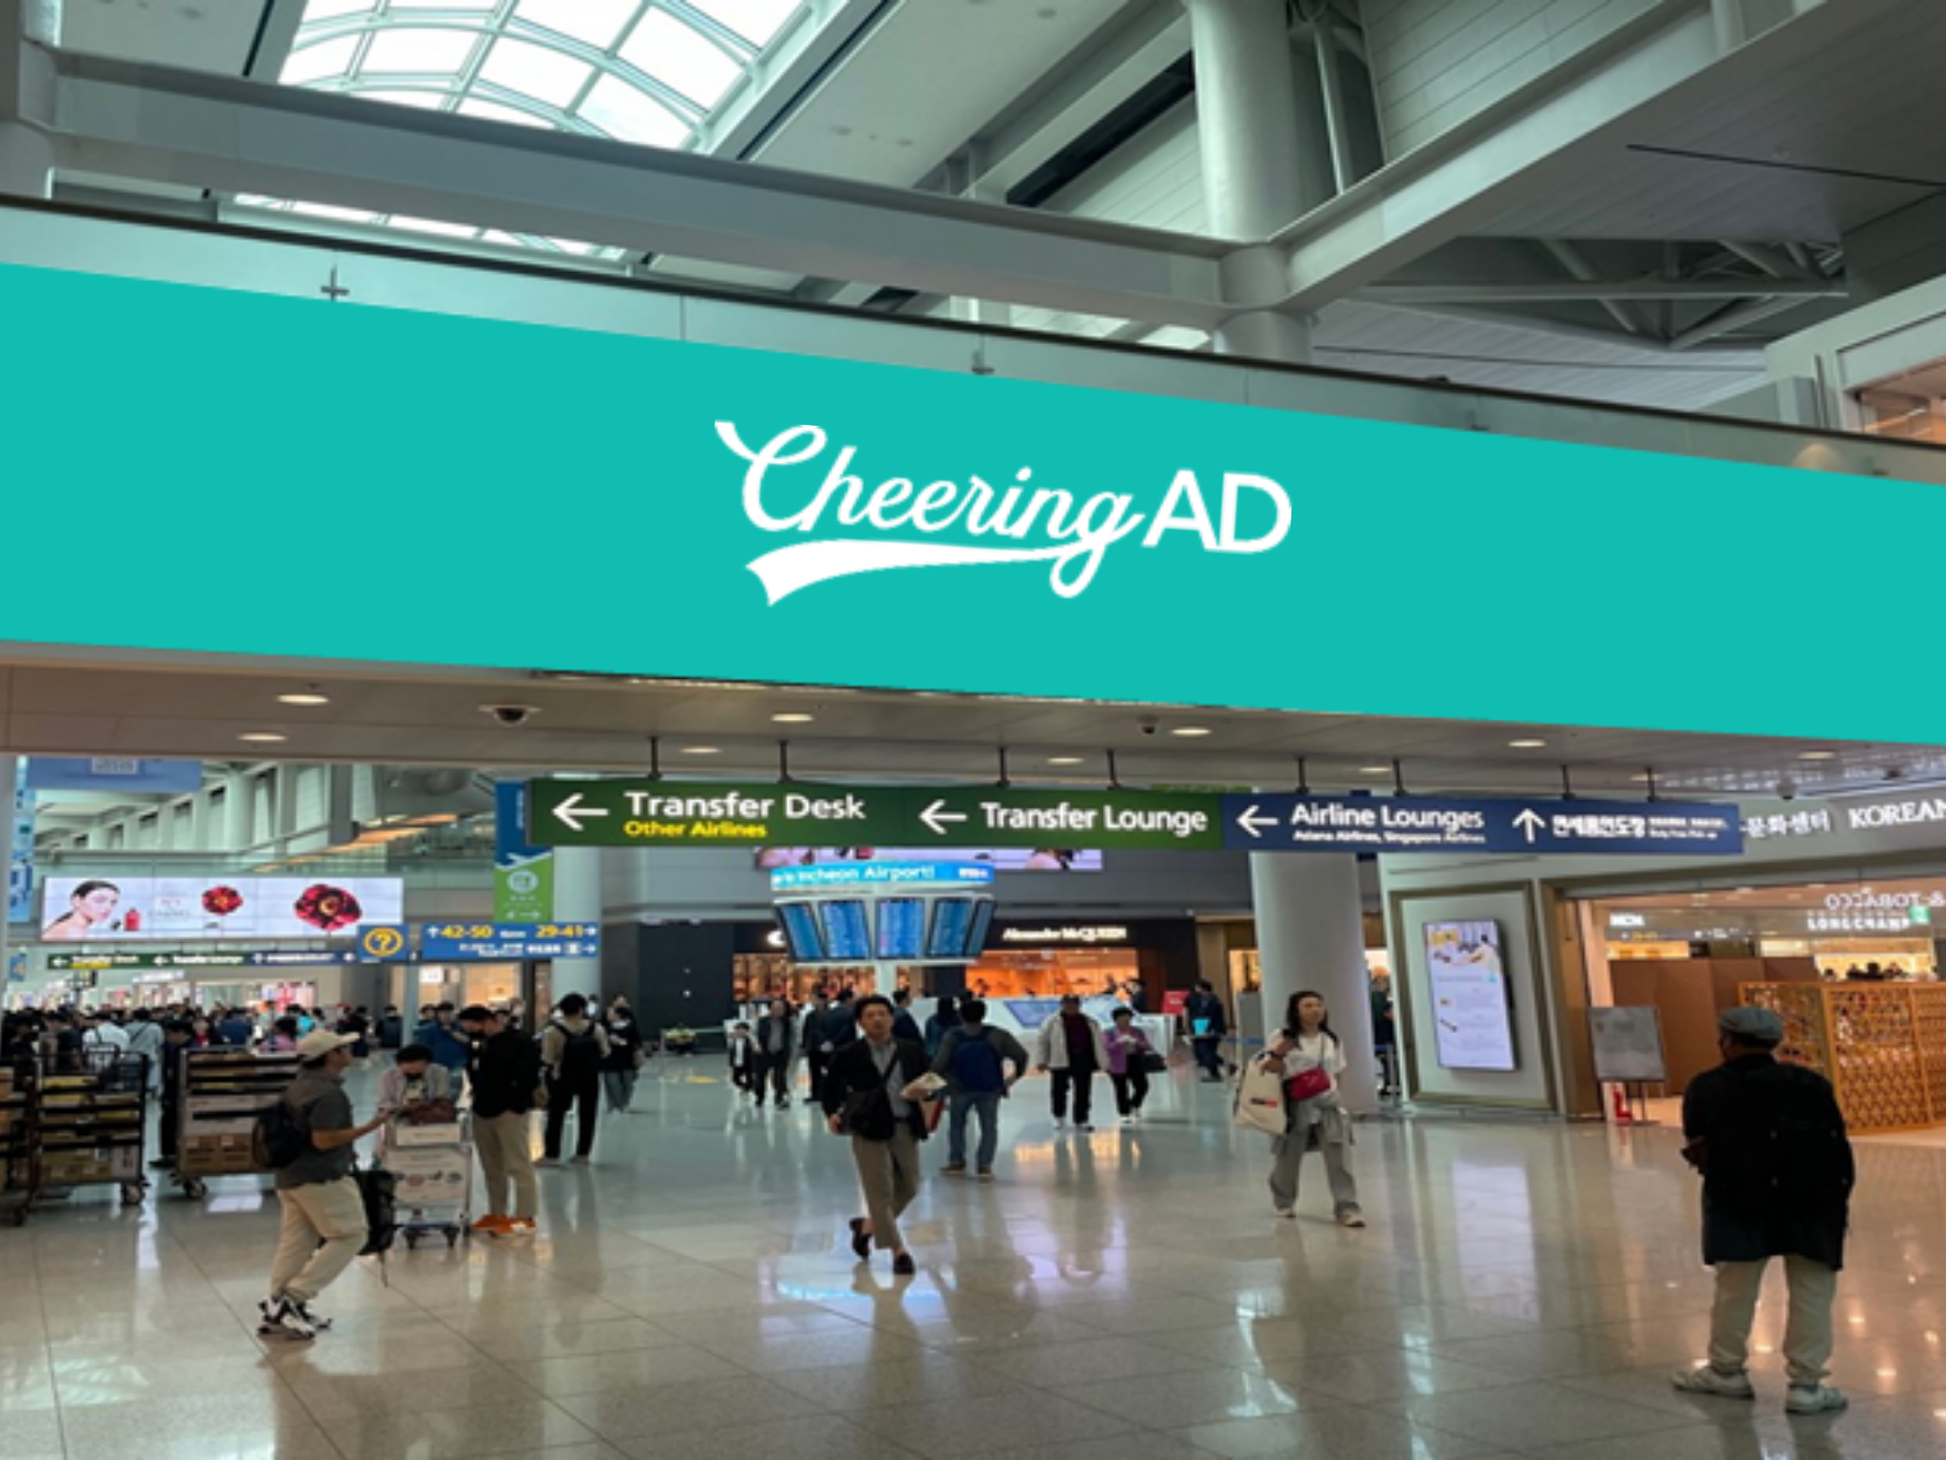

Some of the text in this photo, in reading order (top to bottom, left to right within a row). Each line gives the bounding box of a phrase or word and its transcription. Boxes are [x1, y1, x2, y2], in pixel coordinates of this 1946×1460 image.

[714, 419, 1293, 606] Cheering AD
[623, 791, 867, 820] Transfer Desk
[979, 801, 1209, 838] Transfer Lounge
[1290, 803, 1486, 833] Airline Lounges
[624, 820, 767, 839] Other Airlines
